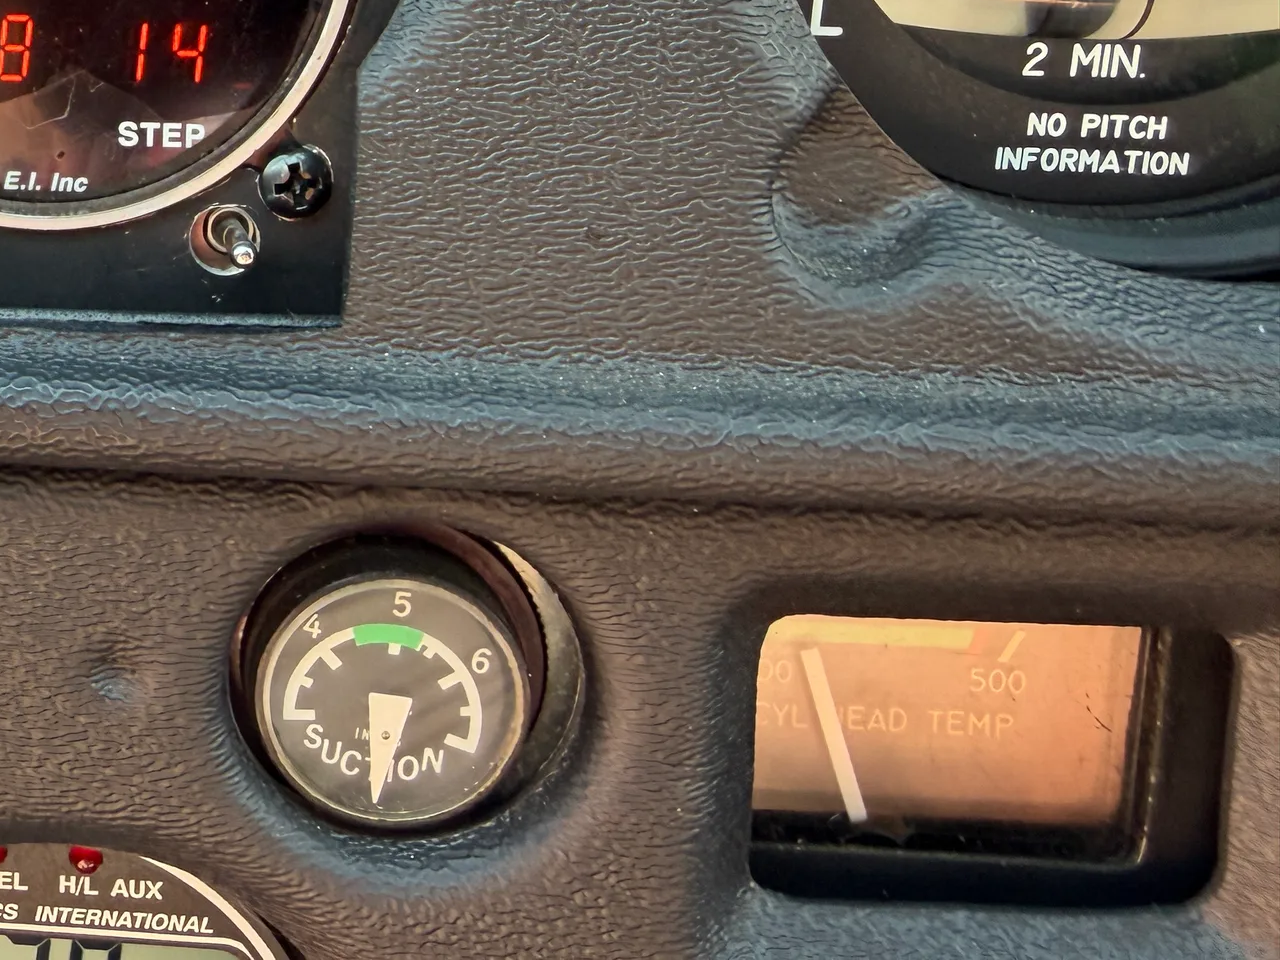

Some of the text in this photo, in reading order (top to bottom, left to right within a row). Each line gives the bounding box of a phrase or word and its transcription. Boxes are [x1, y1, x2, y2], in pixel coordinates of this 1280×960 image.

[135, 22, 208, 83] 14
[1022, 42, 1146, 80] 2 MIN.
[118, 121, 206, 149] STEP
[1026, 112, 1168, 140] NO PITCH
[995, 147, 1190, 176] INFORMATION
[4, 171, 88, 193] E.I. Inc
[392, 591, 412, 618] 5
[302, 614, 322, 639] 4
[471, 648, 492, 674] 6
[969, 668, 1027, 695] 500
[840, 705, 909, 733] EAD
[928, 710, 1014, 740] TEMP
[59, 875, 164, 900] H/L AUX
[34, 905, 214, 934] INTERNATIONAL
